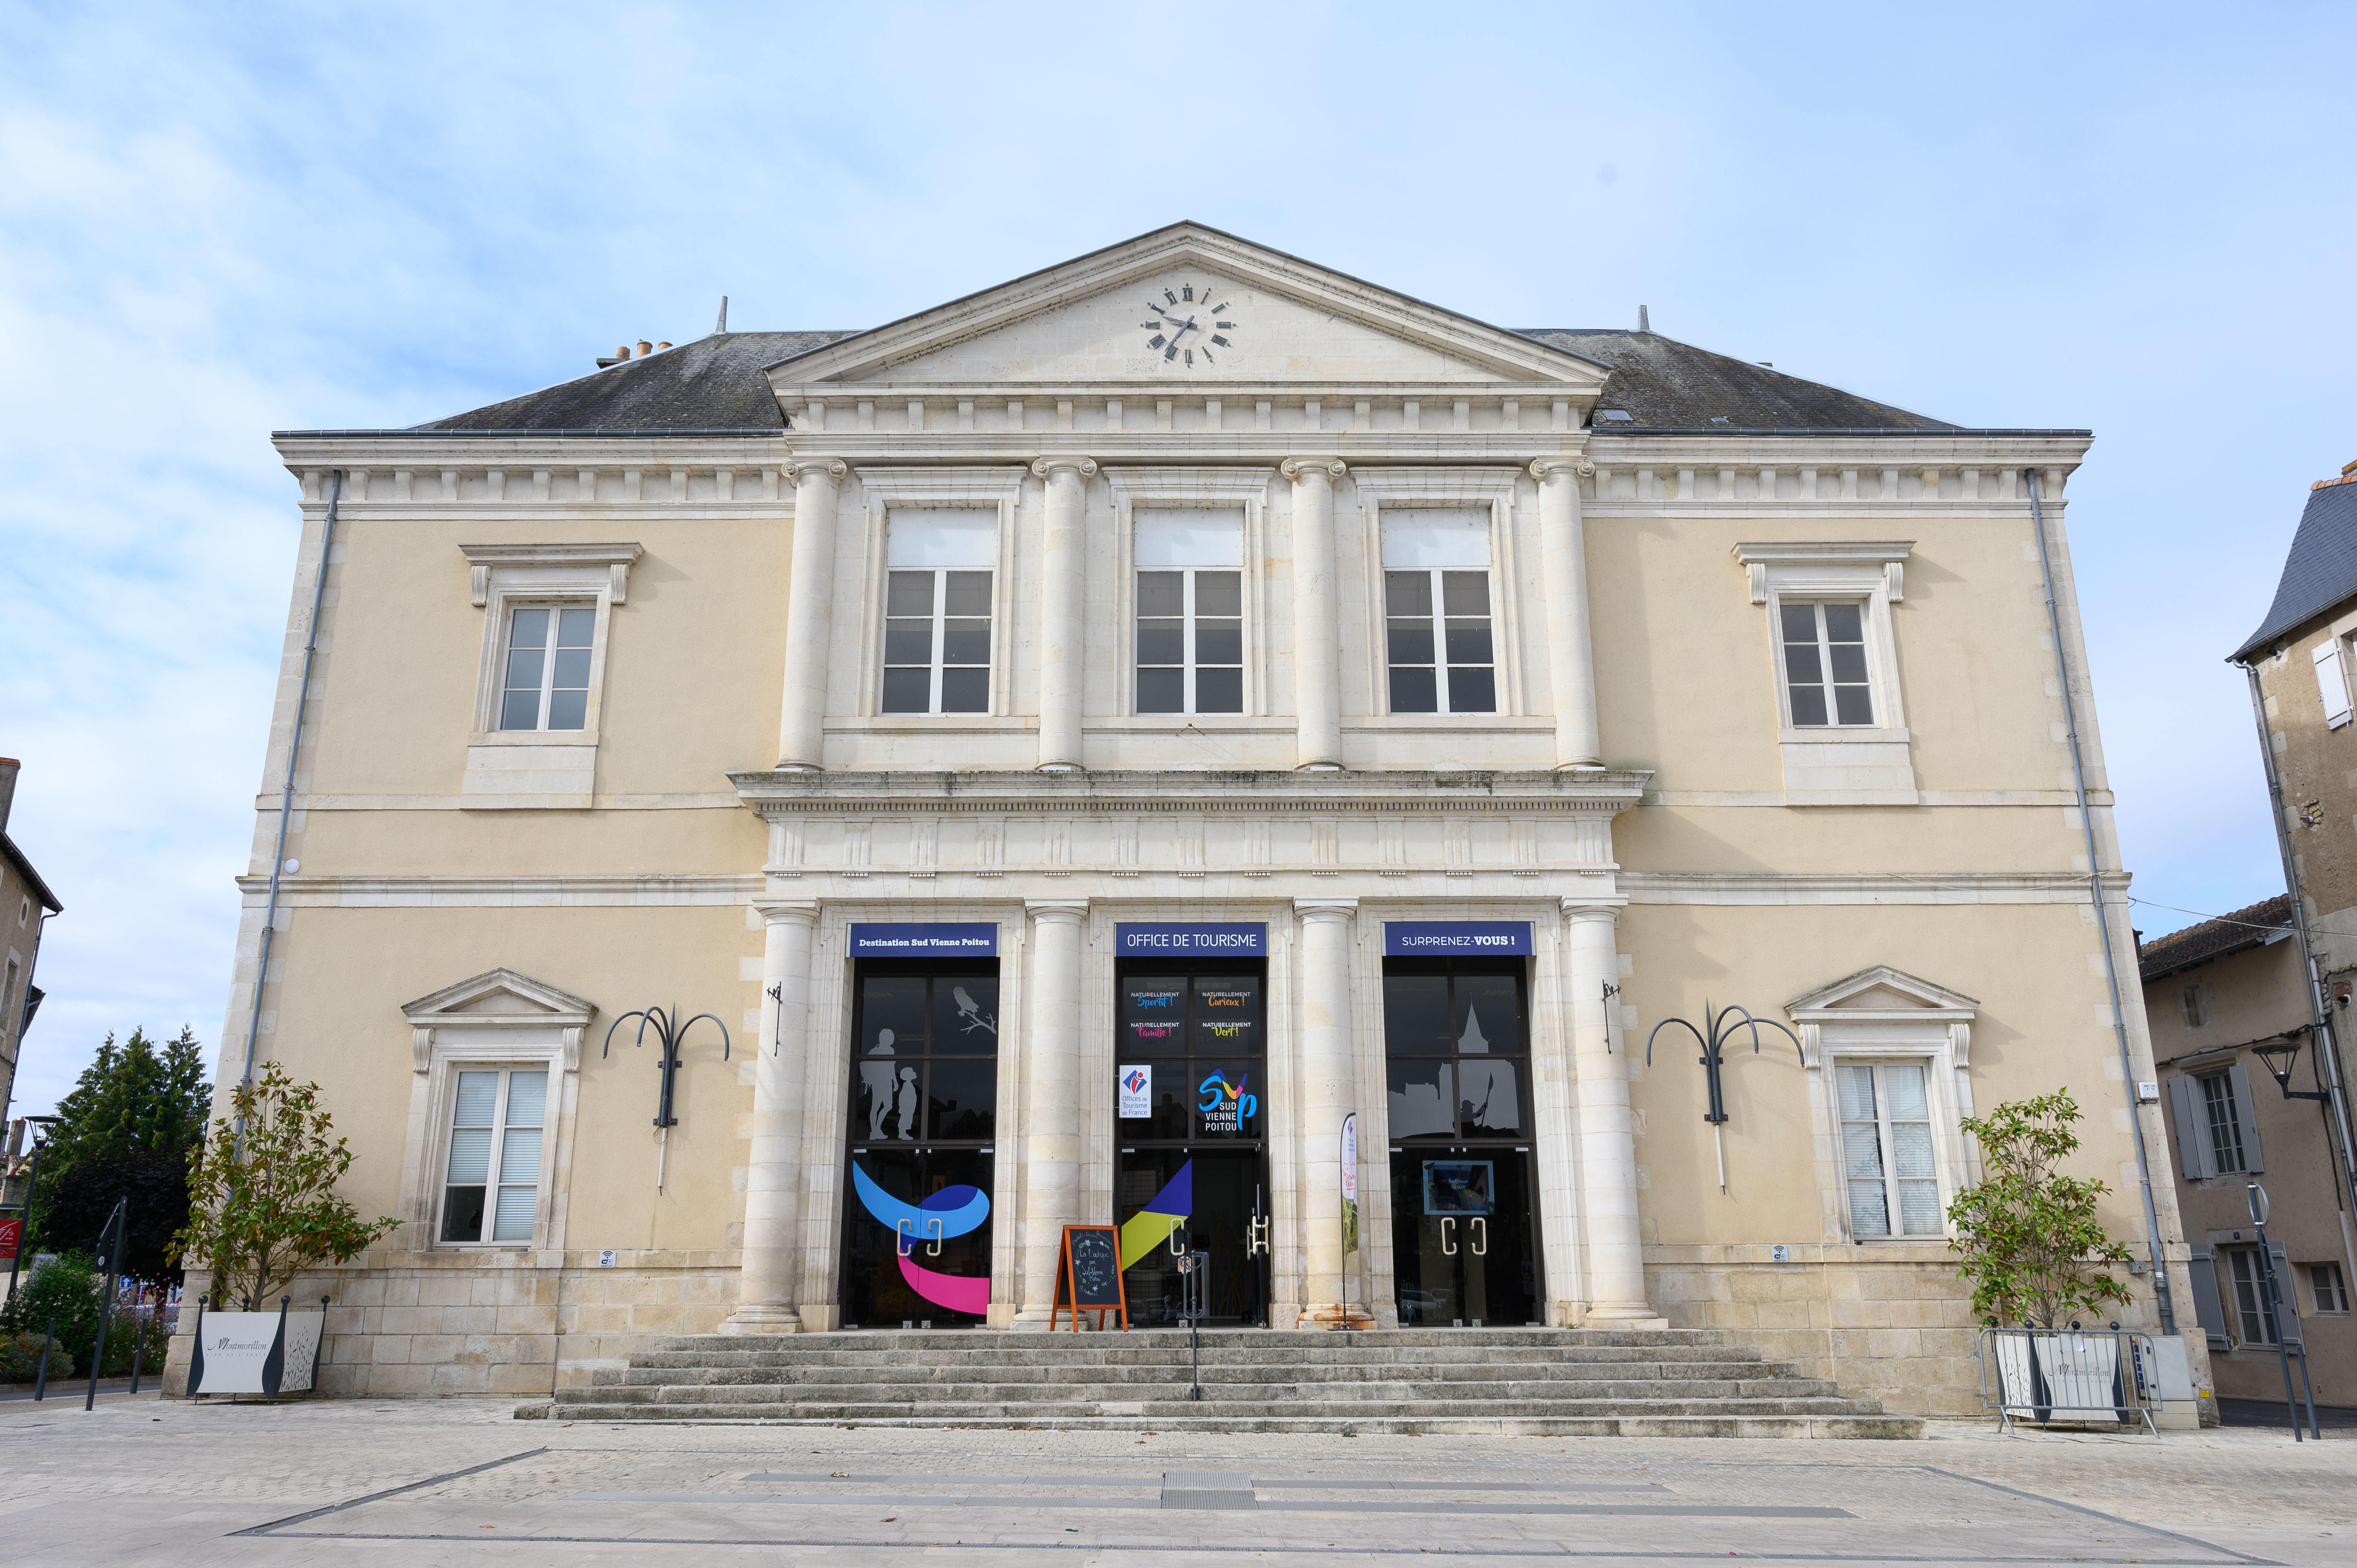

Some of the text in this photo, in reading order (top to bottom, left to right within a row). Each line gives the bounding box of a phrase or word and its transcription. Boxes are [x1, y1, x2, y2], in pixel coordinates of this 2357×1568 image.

[961, 938, 990, 946] Poitou
[1127, 934, 1257, 947] OFFICE DE TOURISME
[1402, 936, 1508, 946] SURPRENEZ-VOUS
[1137, 996, 1168, 1009] Sportif
[1208, 995, 1239, 1007] Curieux
[1136, 1025, 1167, 1038] Famille
[1206, 1123, 1237, 1131] POITOU
[207, 1337, 267, 1350] Montmorillon
